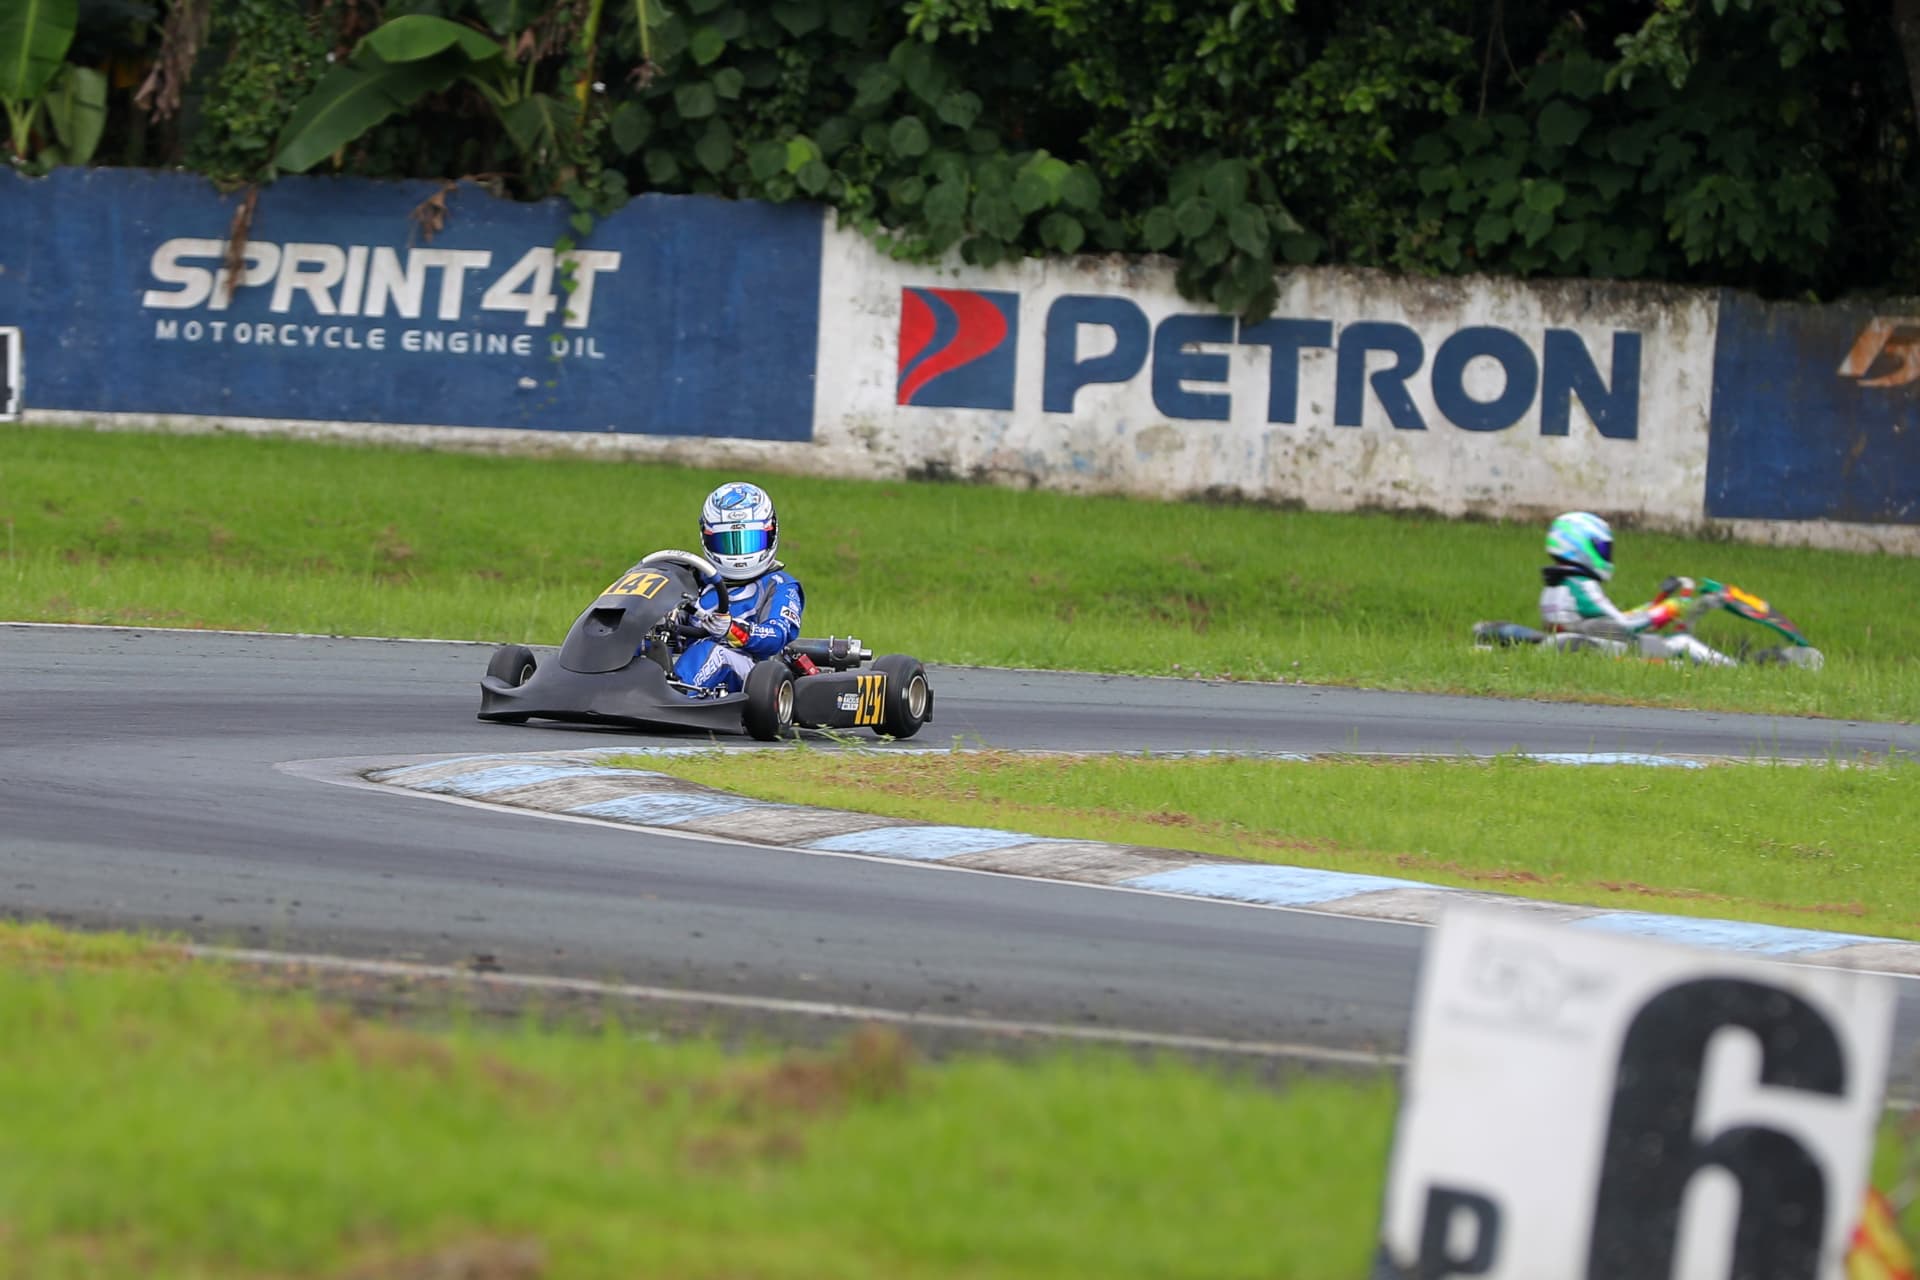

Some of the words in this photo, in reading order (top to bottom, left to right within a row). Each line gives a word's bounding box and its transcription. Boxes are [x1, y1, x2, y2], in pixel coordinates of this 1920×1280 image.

[143, 238, 492, 320] SPRINT
[481, 246, 622, 329] 4T
[156, 319, 386, 350] MOTORCYCLE
[402, 330, 532, 357] ENGINE
[551, 337, 605, 359] OIL
[1042, 294, 1641, 439] PETRON
[857, 675, 884, 725] 141
[1583, 976, 1850, 1280] 6
